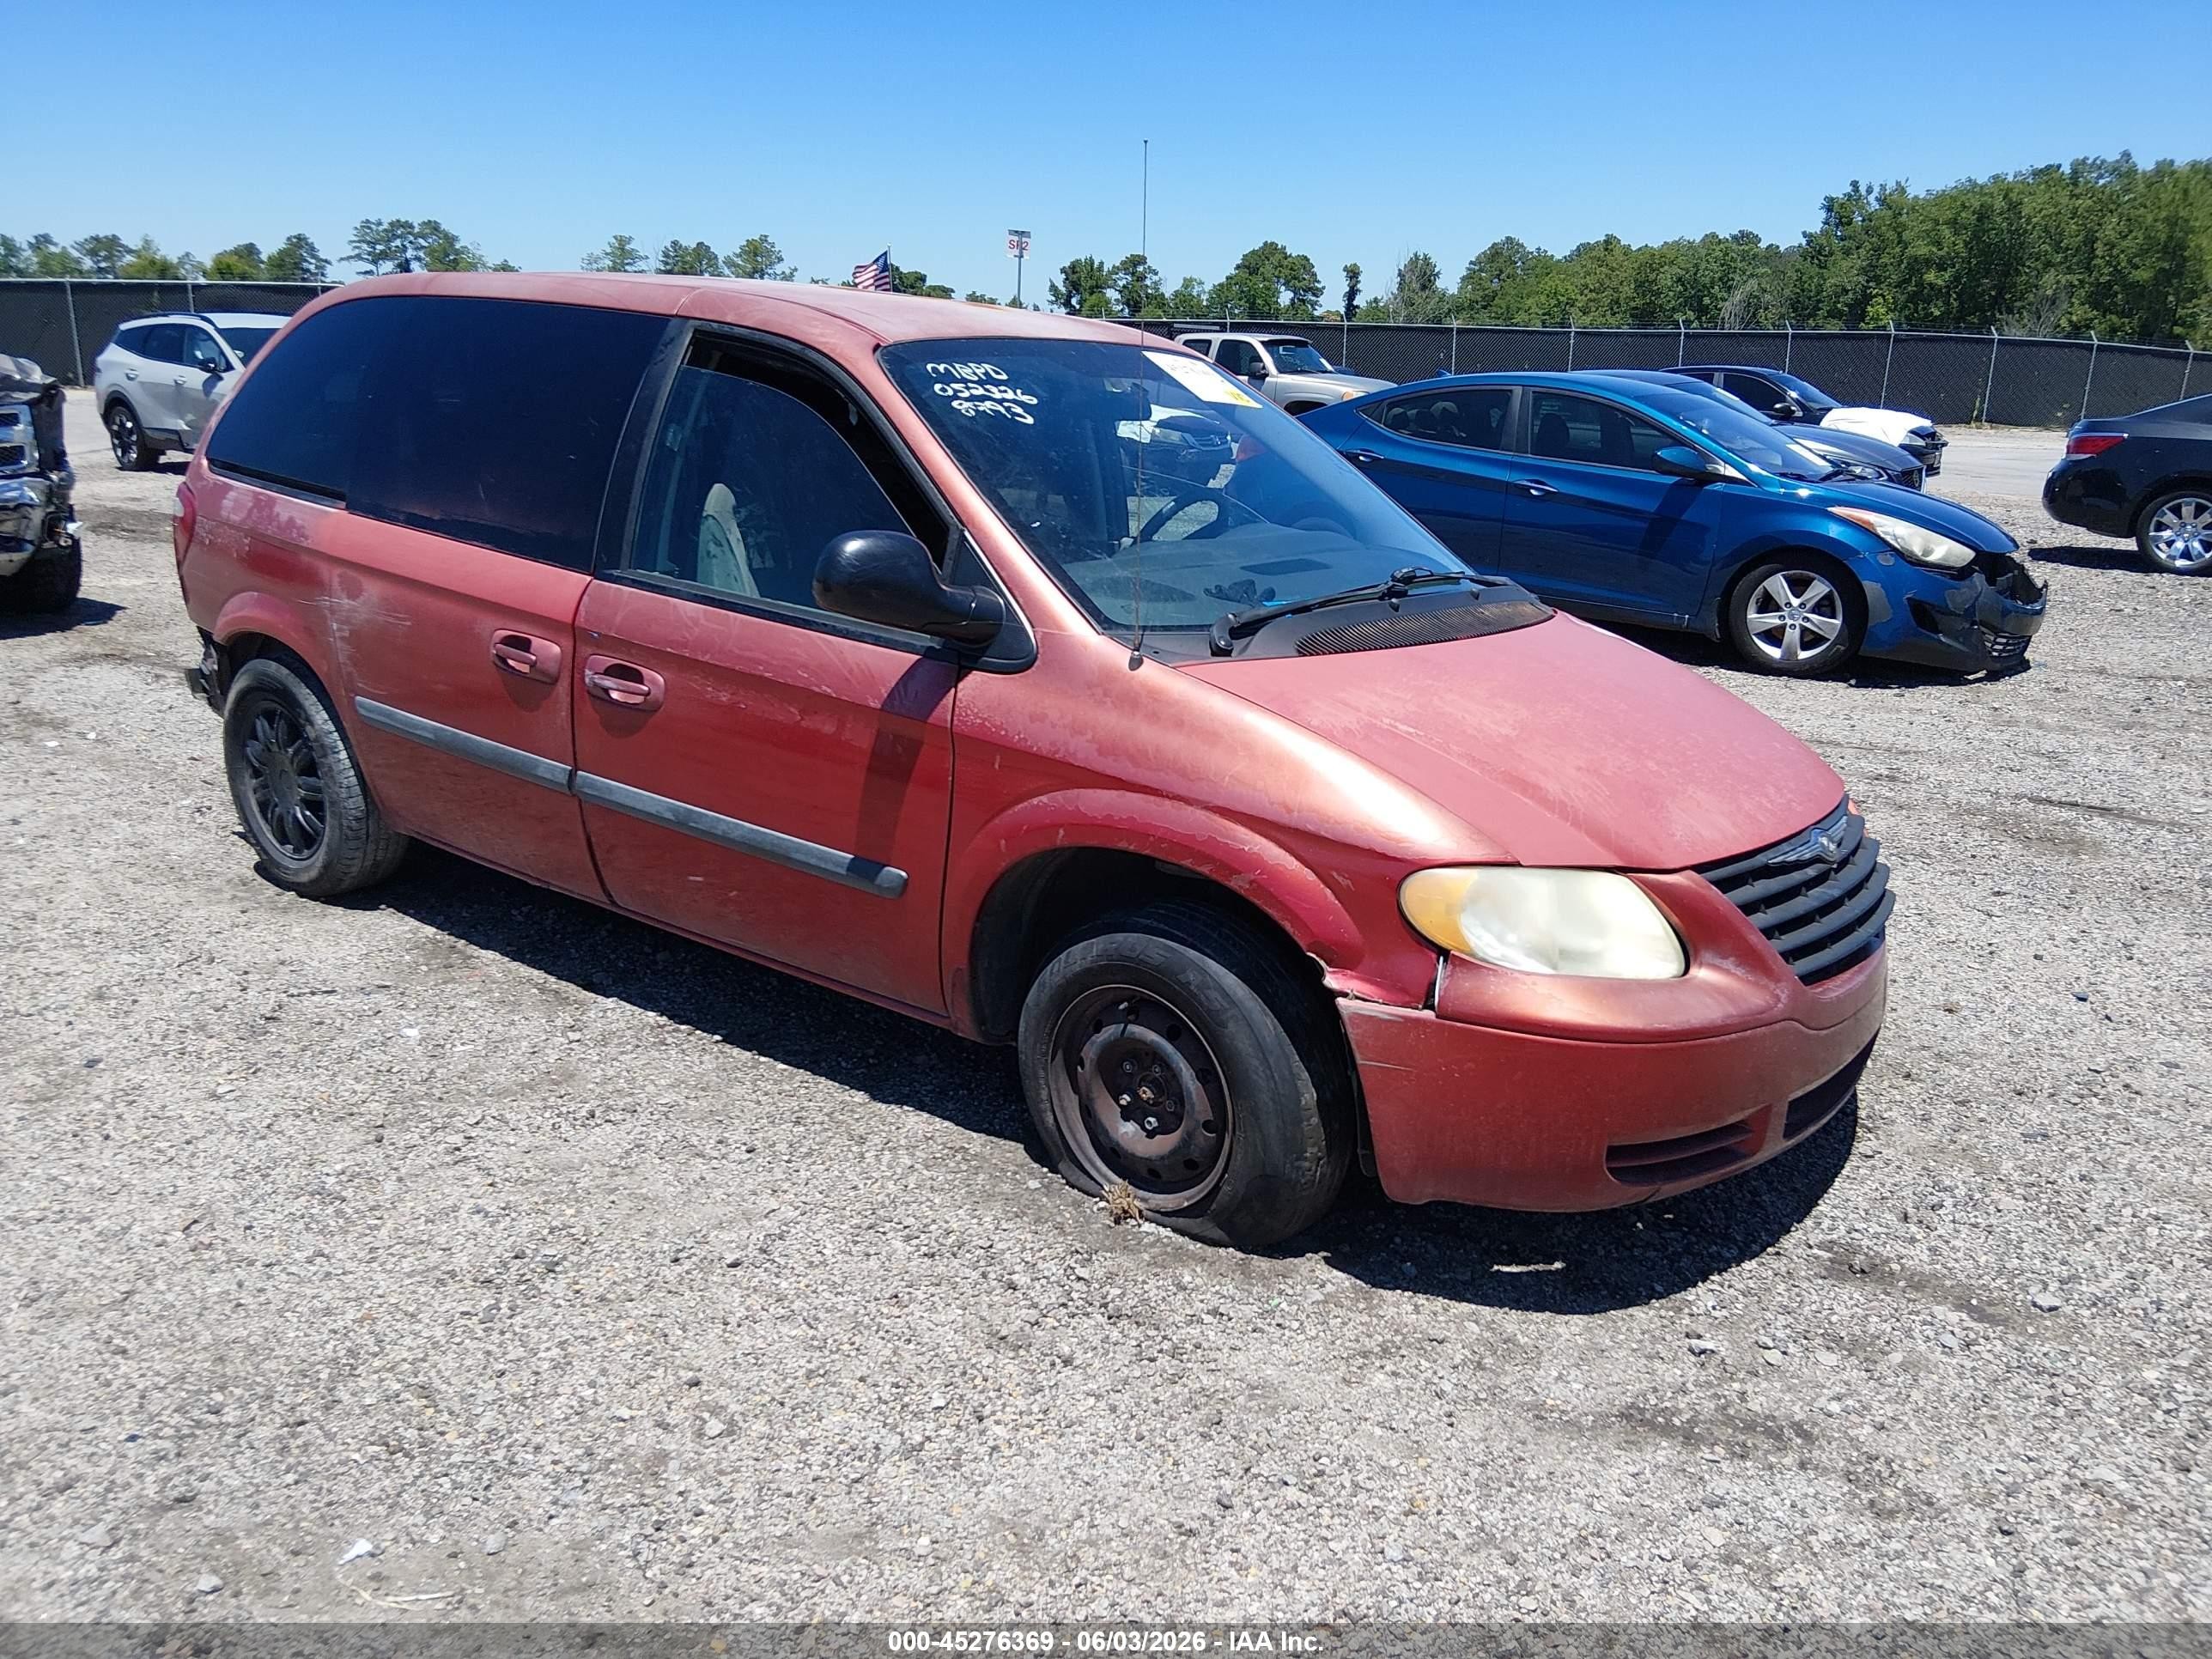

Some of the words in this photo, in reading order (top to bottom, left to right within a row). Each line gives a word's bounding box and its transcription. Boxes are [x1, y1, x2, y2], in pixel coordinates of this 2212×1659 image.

[927, 362, 1008, 380] MBPD
[933, 383, 1038, 404] 052326
[951, 399, 1035, 424] 8793
